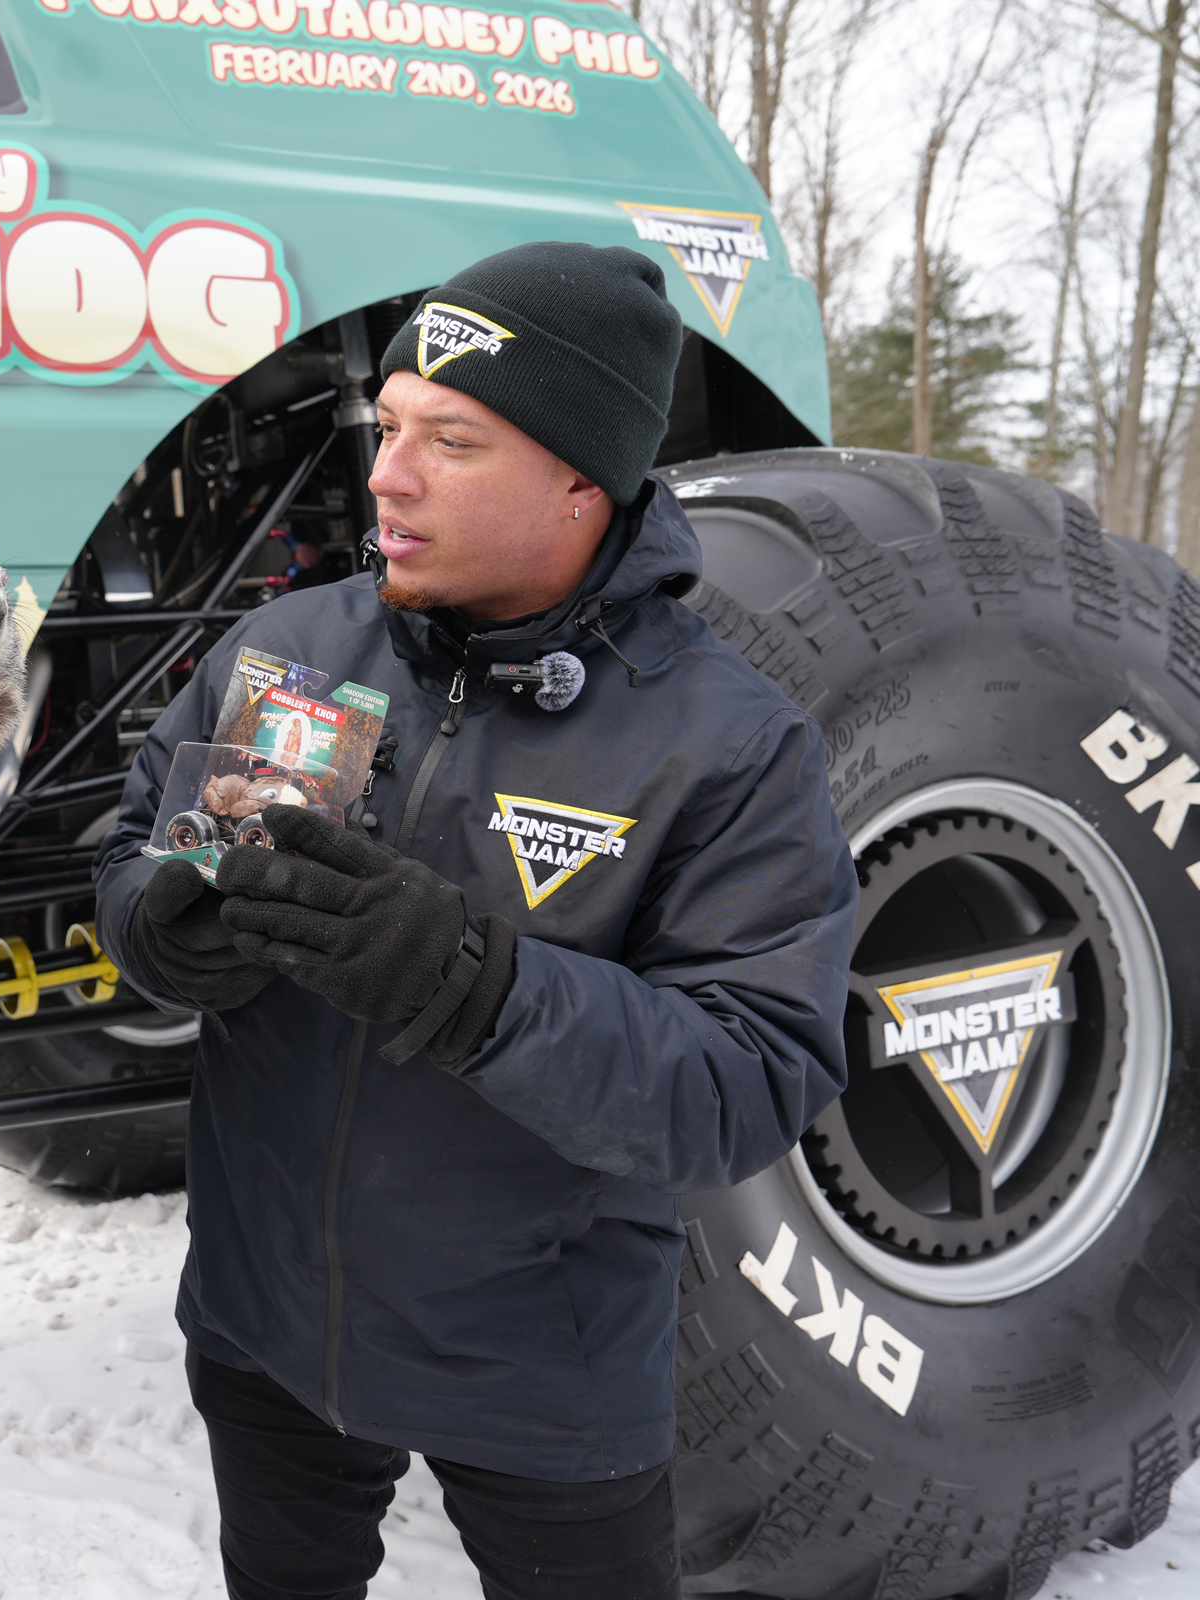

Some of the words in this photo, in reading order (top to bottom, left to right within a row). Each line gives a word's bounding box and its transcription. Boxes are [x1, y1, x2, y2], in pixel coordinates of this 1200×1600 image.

[532, 15, 660, 78] PHIL
[210, 42, 398, 92] FEBRUARY
[404, 59, 487, 106] 2ND,
[492, 69, 575, 115] 2026
[631, 217, 770, 262] MONSTER
[684, 247, 744, 281] JAM
[413, 312, 503, 356] MONSTER
[420, 330, 468, 355] JAM
[238, 664, 283, 686] MONSTER
[247, 677, 269, 690] JAM
[271, 691, 312, 713] GOBBLER'S
[314, 707, 337, 722] KNOB
[342, 687, 364, 699] SHADOW
[364, 693, 385, 706] EDITION
[360, 700, 374, 710] 5,000
[260, 712, 286, 722] HOME
[265, 720, 276, 729] OF
[487, 812, 627, 860] MONSTER
[516, 841, 582, 872] JAM
[883, 986, 1063, 1058] MONSTER
[939, 1032, 1019, 1083] JAM
[739, 1221, 925, 1417] BKT
